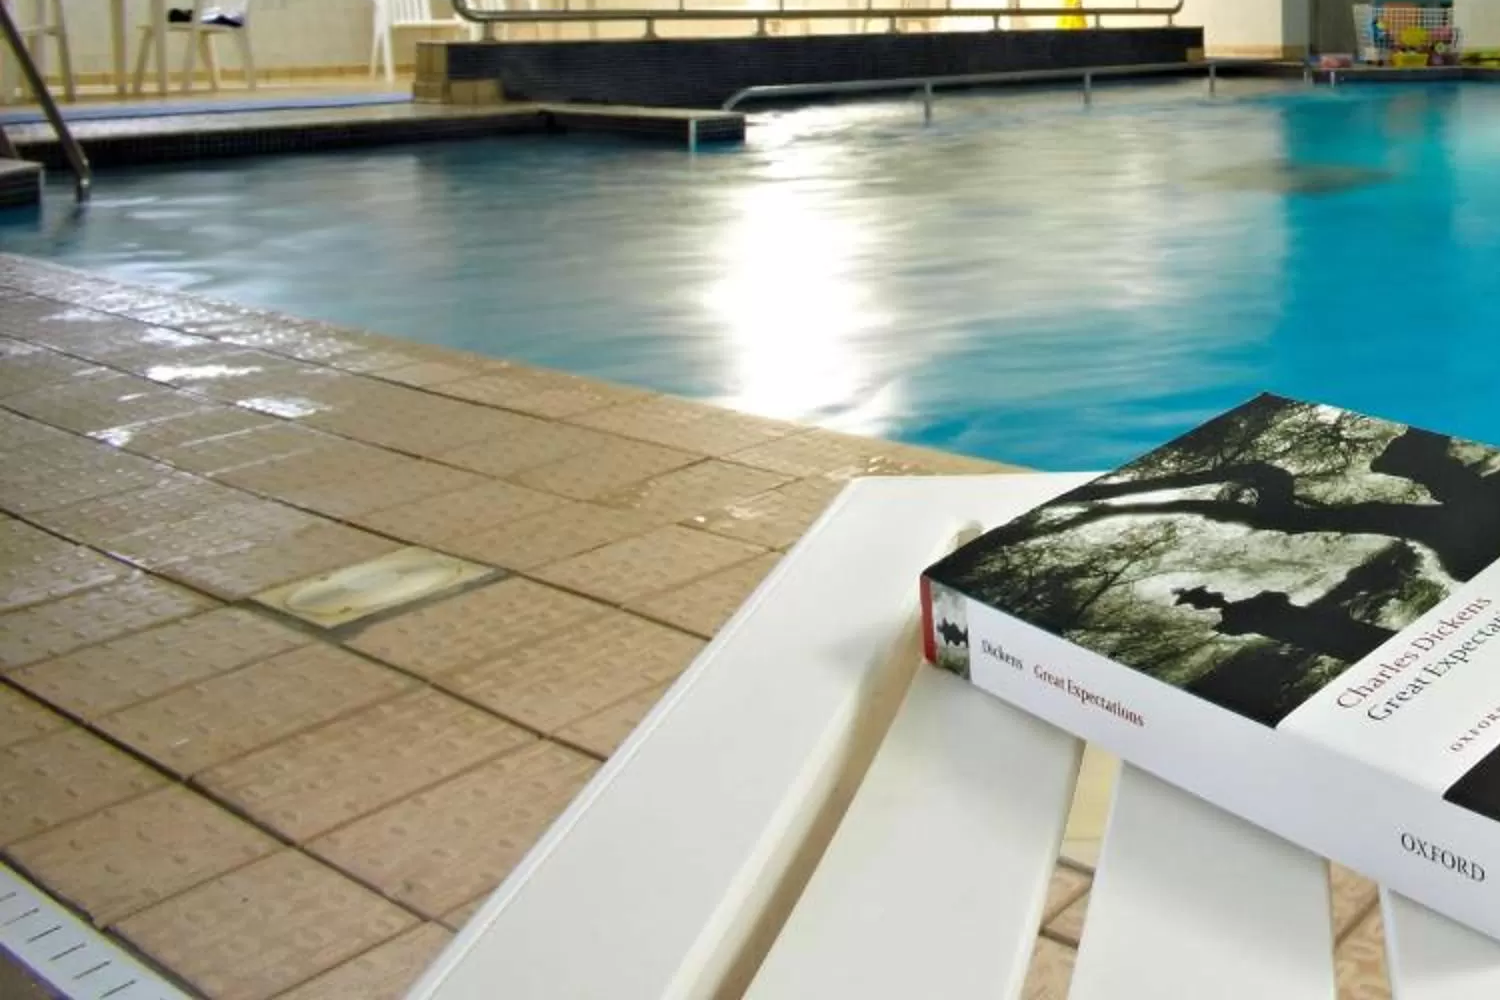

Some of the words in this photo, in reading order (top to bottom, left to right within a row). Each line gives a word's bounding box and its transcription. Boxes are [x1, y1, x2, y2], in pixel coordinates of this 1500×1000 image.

[981, 639, 1024, 671] Dickens
[1033, 663, 1065, 691] Great
[1067, 678, 1145, 728] Expectations
[1337, 652, 1420, 709] Charles
[1411, 596, 1492, 652] Dickens
[1367, 675, 1432, 721] Great
[1401, 832, 1485, 882] OXFORD
